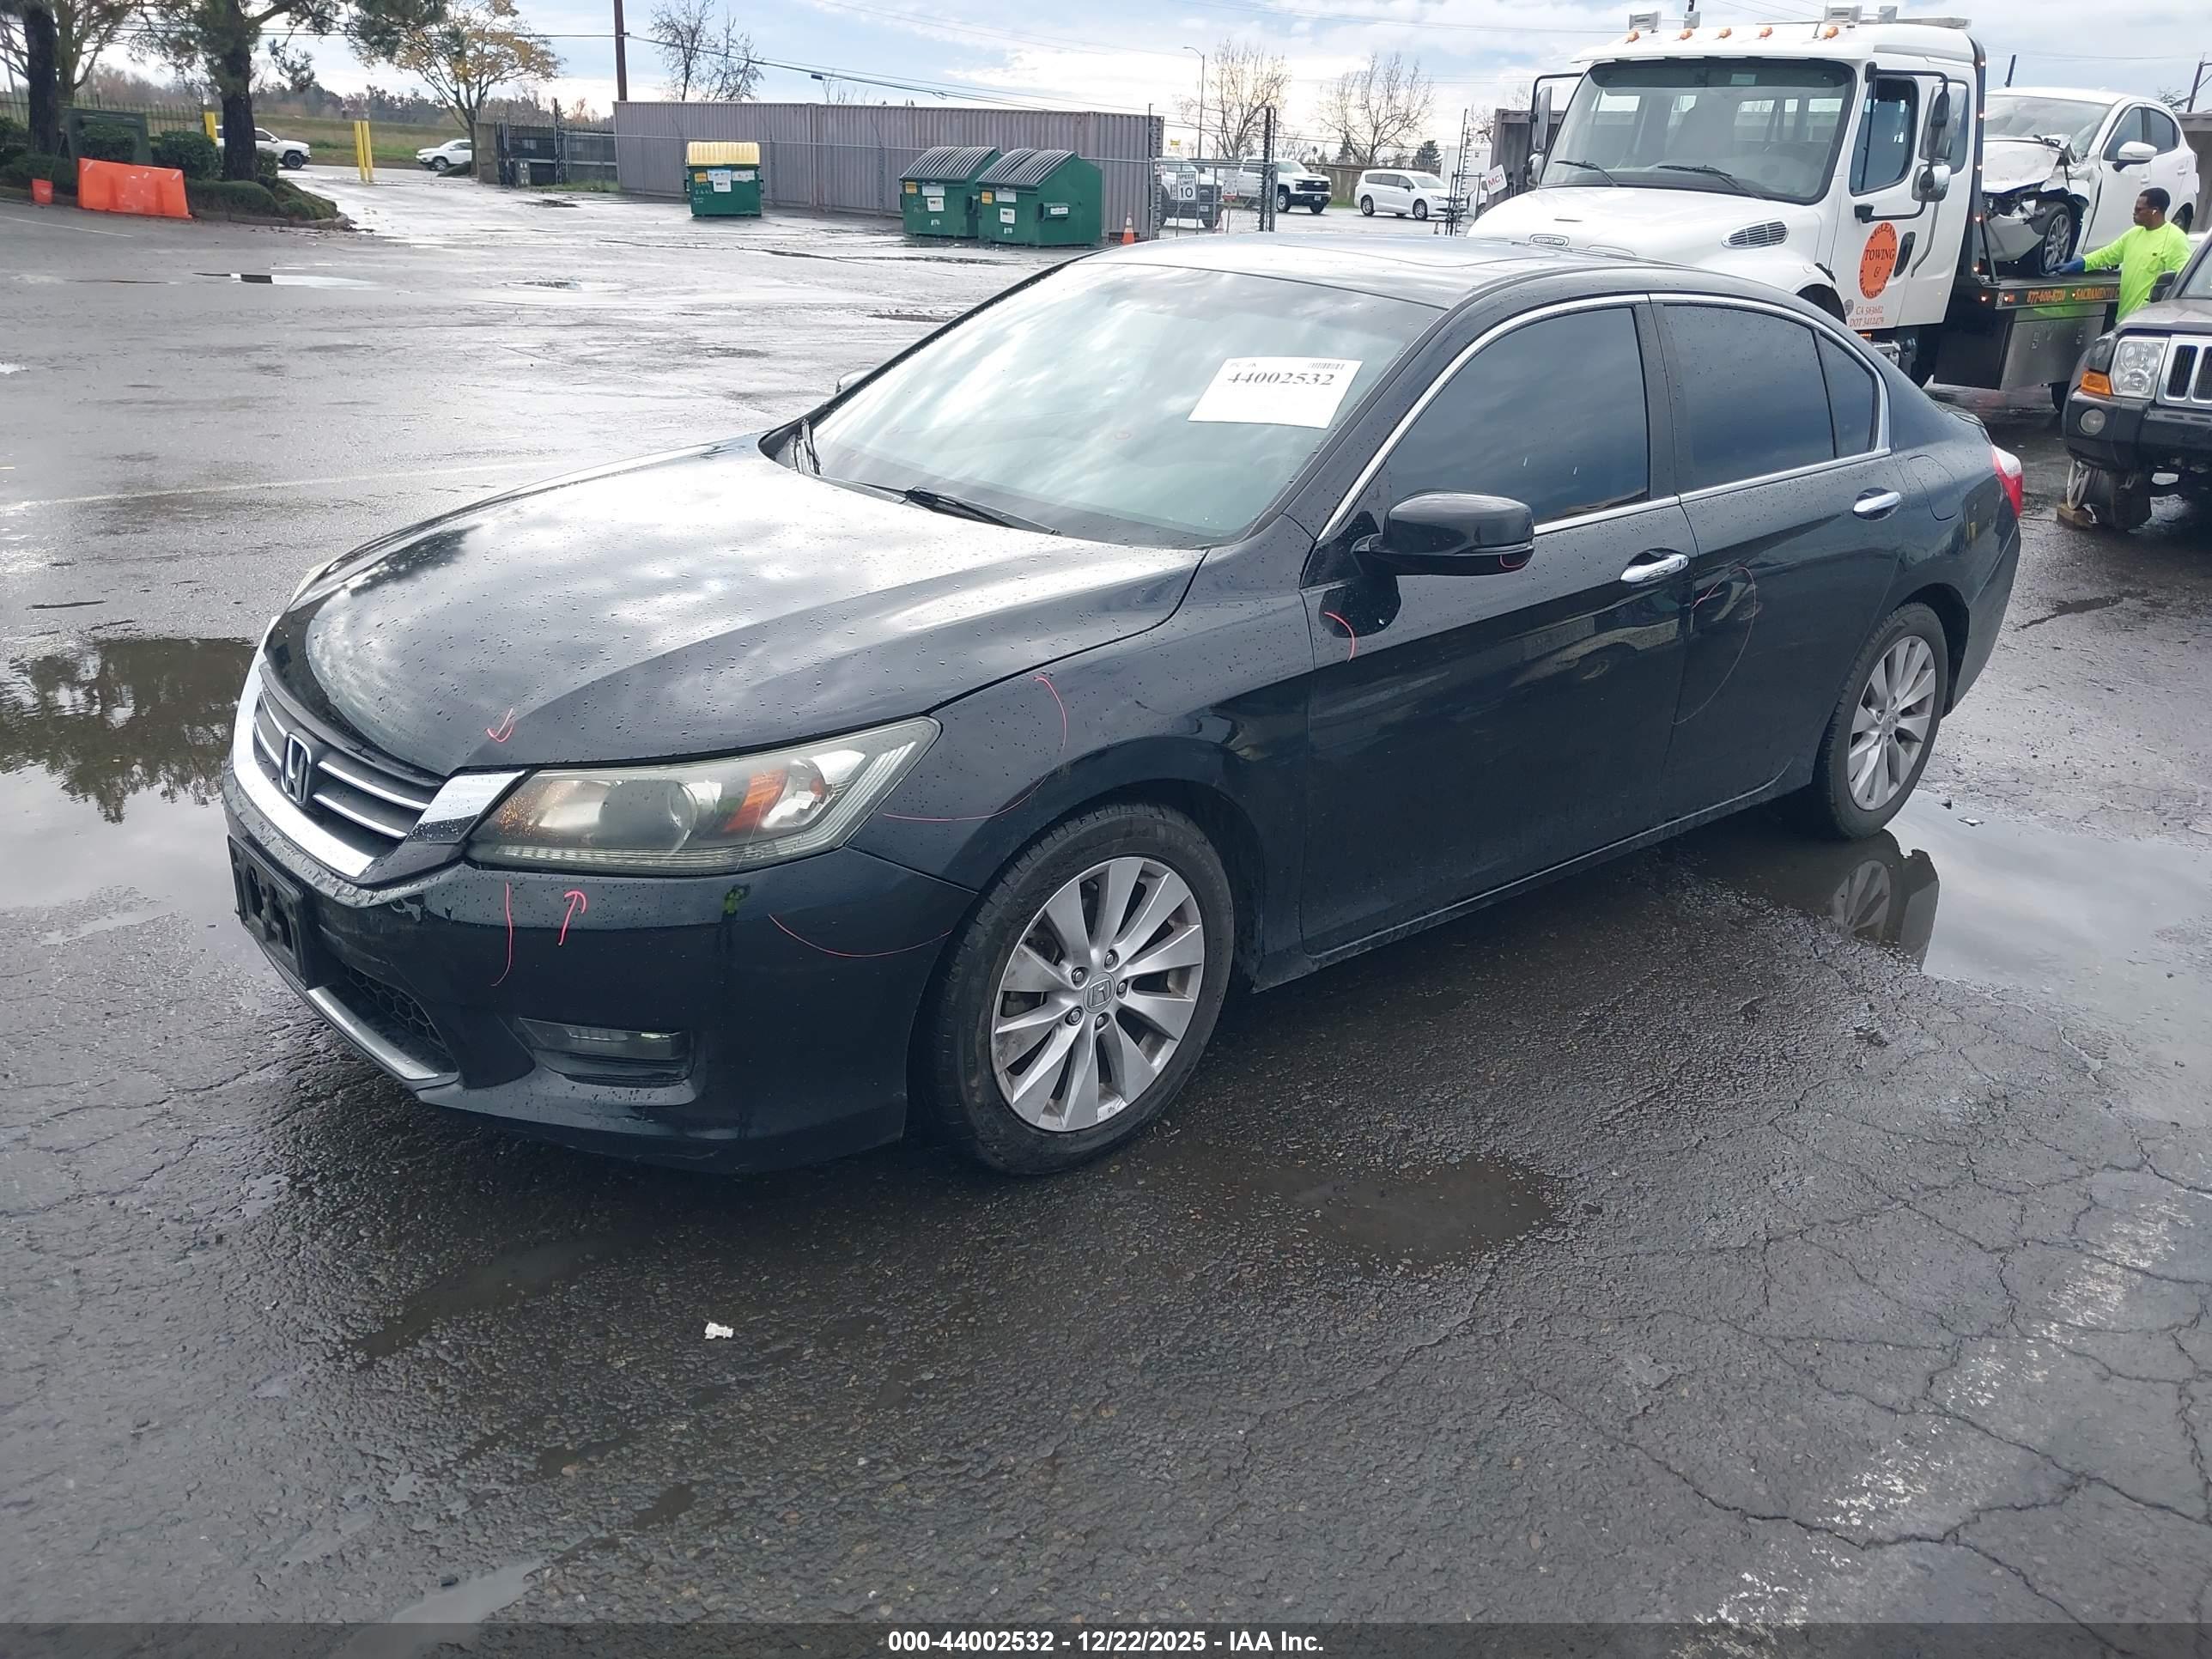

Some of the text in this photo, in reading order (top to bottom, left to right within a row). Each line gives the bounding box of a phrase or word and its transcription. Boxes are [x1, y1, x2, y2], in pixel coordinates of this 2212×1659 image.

[1488, 173, 1504, 187] MC1
[1181, 186, 1194, 198] 10
[1864, 249, 1895, 260] TOWING
[1227, 371, 1335, 386] 44002532
